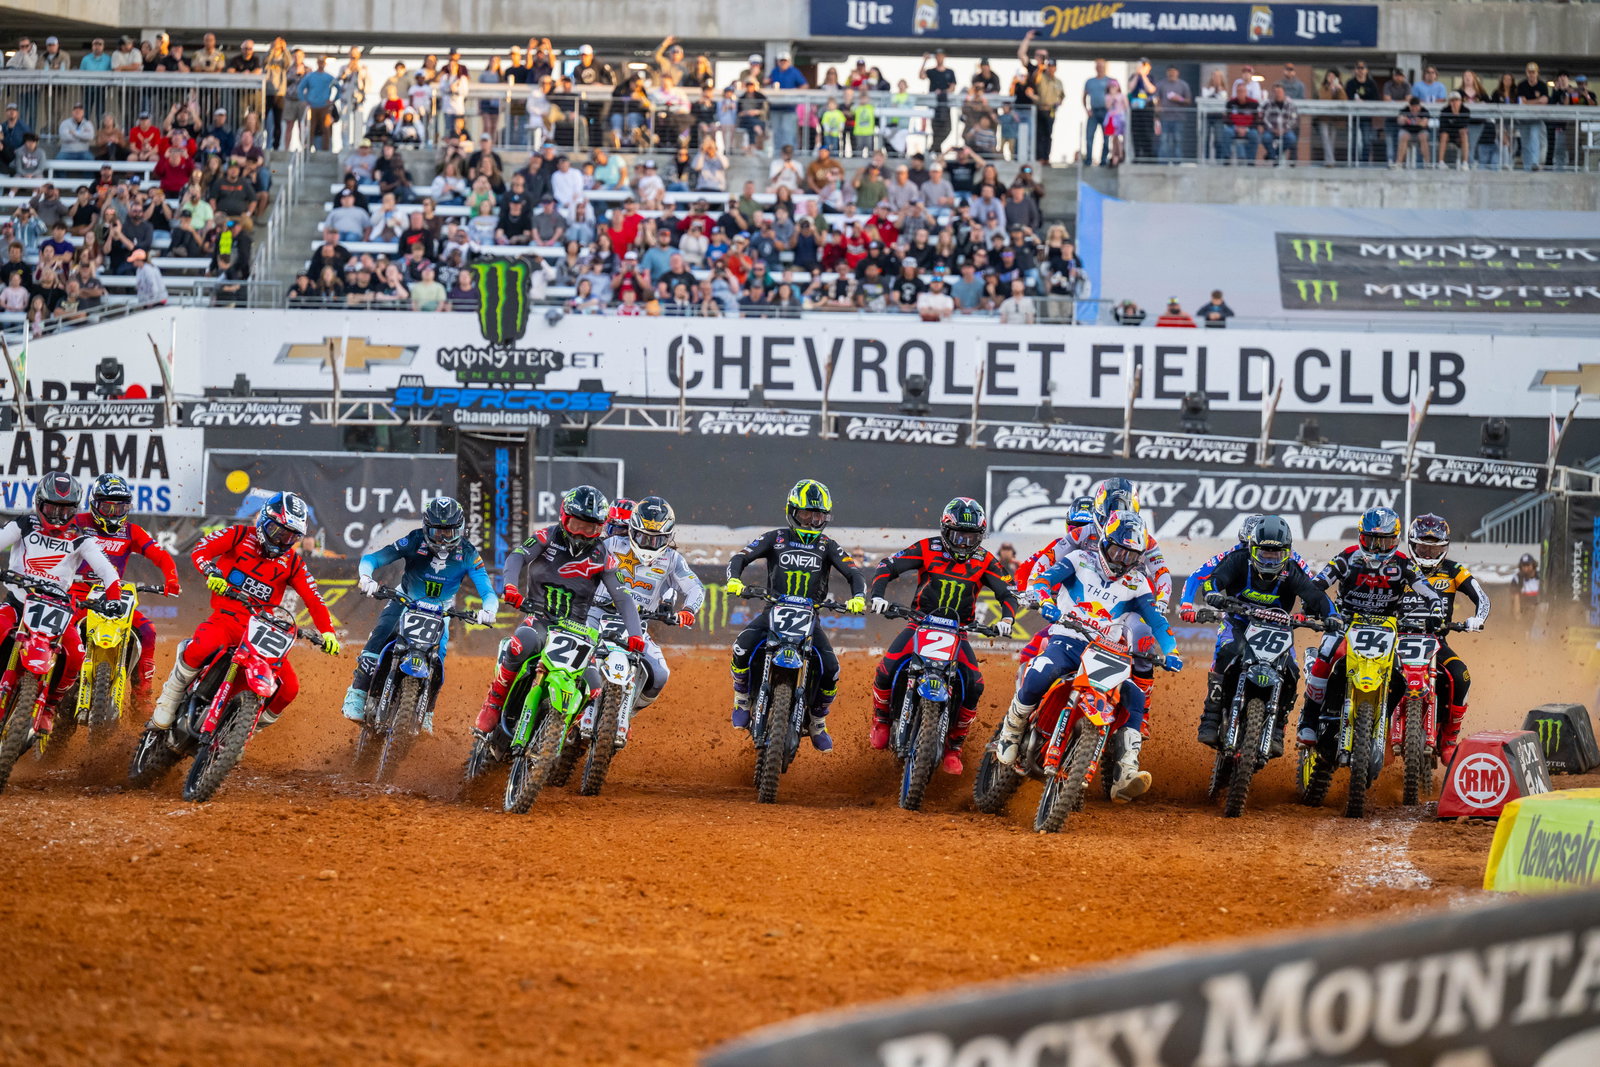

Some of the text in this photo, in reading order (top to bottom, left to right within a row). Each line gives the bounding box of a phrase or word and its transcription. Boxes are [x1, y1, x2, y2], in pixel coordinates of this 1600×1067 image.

[847, 1, 893, 30] Lite
[950, 9, 1009, 27] TASTES
[1010, 10, 1046, 28] LIKE
[1040, 2, 1125, 37] Miller
[1111, 12, 1155, 31] TIME,
[1157, 13, 1237, 31] ALABAMA
[1296, 9, 1342, 39] Lite
[1360, 242, 1600, 261] MONSTER
[1364, 283, 1600, 299] MONSTER
[440, 345, 558, 369] MONSTER
[400, 375, 425, 388] AMA
[458, 371, 539, 380] ENERGY
[667, 335, 1466, 406] CHEVROLET FIELD CLUB
[61, 403, 156, 414] ROCKY MOUNTAIN
[209, 402, 303, 413] ROCKY MOUNTAIN
[393, 387, 615, 411] SUPERCROSS
[453, 408, 551, 427] Championship
[717, 411, 811, 423] ROCKY MOUNTAIN
[864, 417, 959, 431] ROCKY MOUNTAIN
[1012, 425, 1106, 440] ROCKY MOUNTAIN
[1154, 436, 1248, 451] ROCKY MOUNTAIN
[1300, 446, 1395, 462] ROCKY MOUNTAIN
[1445, 459, 1538, 476] ROCKY MOUNTAIN
[345, 487, 443, 514] UTAH
[1187, 477, 1401, 513] MOUNTAIN
[24, 568, 61, 581] HONDA
[235, 551, 285, 581] FLY
[928, 556, 982, 580] FLY
[242, 583, 271, 601] LOCK
[245, 577, 273, 595] QUAD
[28, 603, 65, 636] 14
[405, 614, 443, 644] 28
[774, 608, 811, 635] 32
[250, 625, 291, 657] 12
[548, 635, 593, 669] 21
[920, 631, 955, 660] 2
[1249, 629, 1289, 654] 46
[1353, 631, 1388, 653] 94
[1397, 638, 1437, 659] 51
[1087, 653, 1128, 682] 7
[1466, 769, 1501, 792] RM
